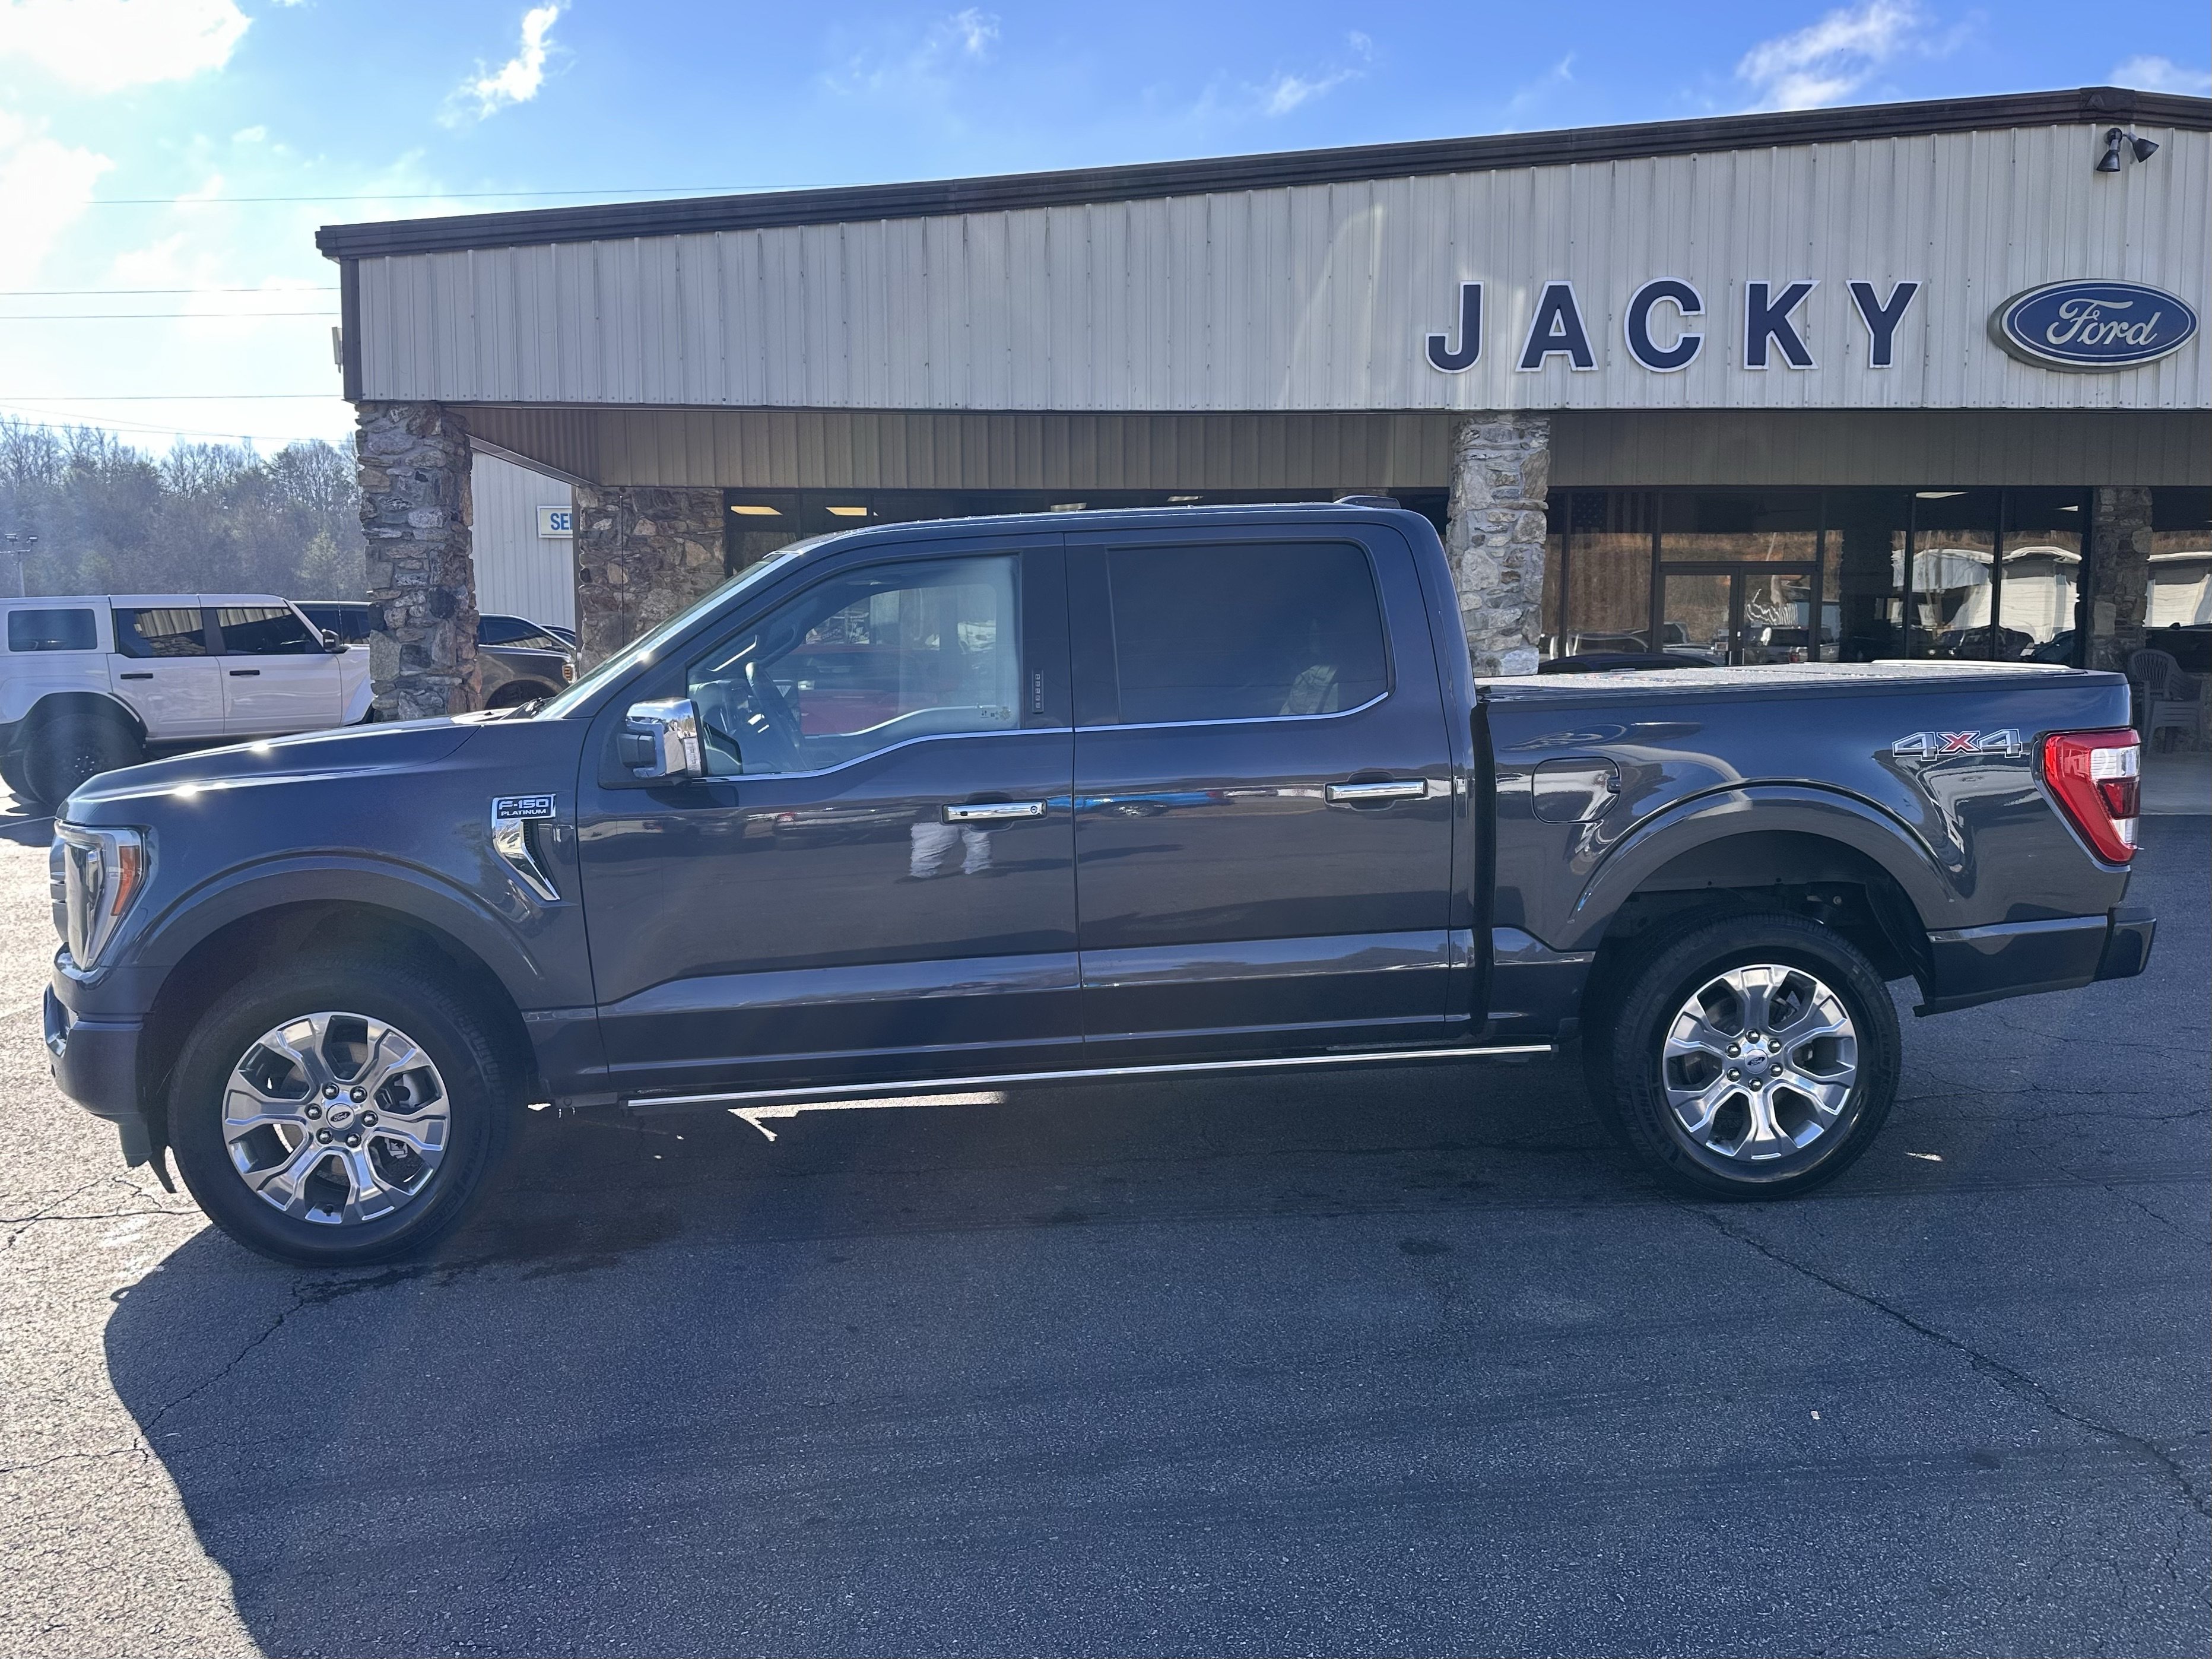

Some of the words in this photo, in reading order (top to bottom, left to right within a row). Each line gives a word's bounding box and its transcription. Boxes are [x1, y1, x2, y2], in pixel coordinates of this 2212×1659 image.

[1425, 276, 1923, 373] JACKY
[2045, 299, 2162, 346] Ford
[499, 799, 549, 810] F-150
